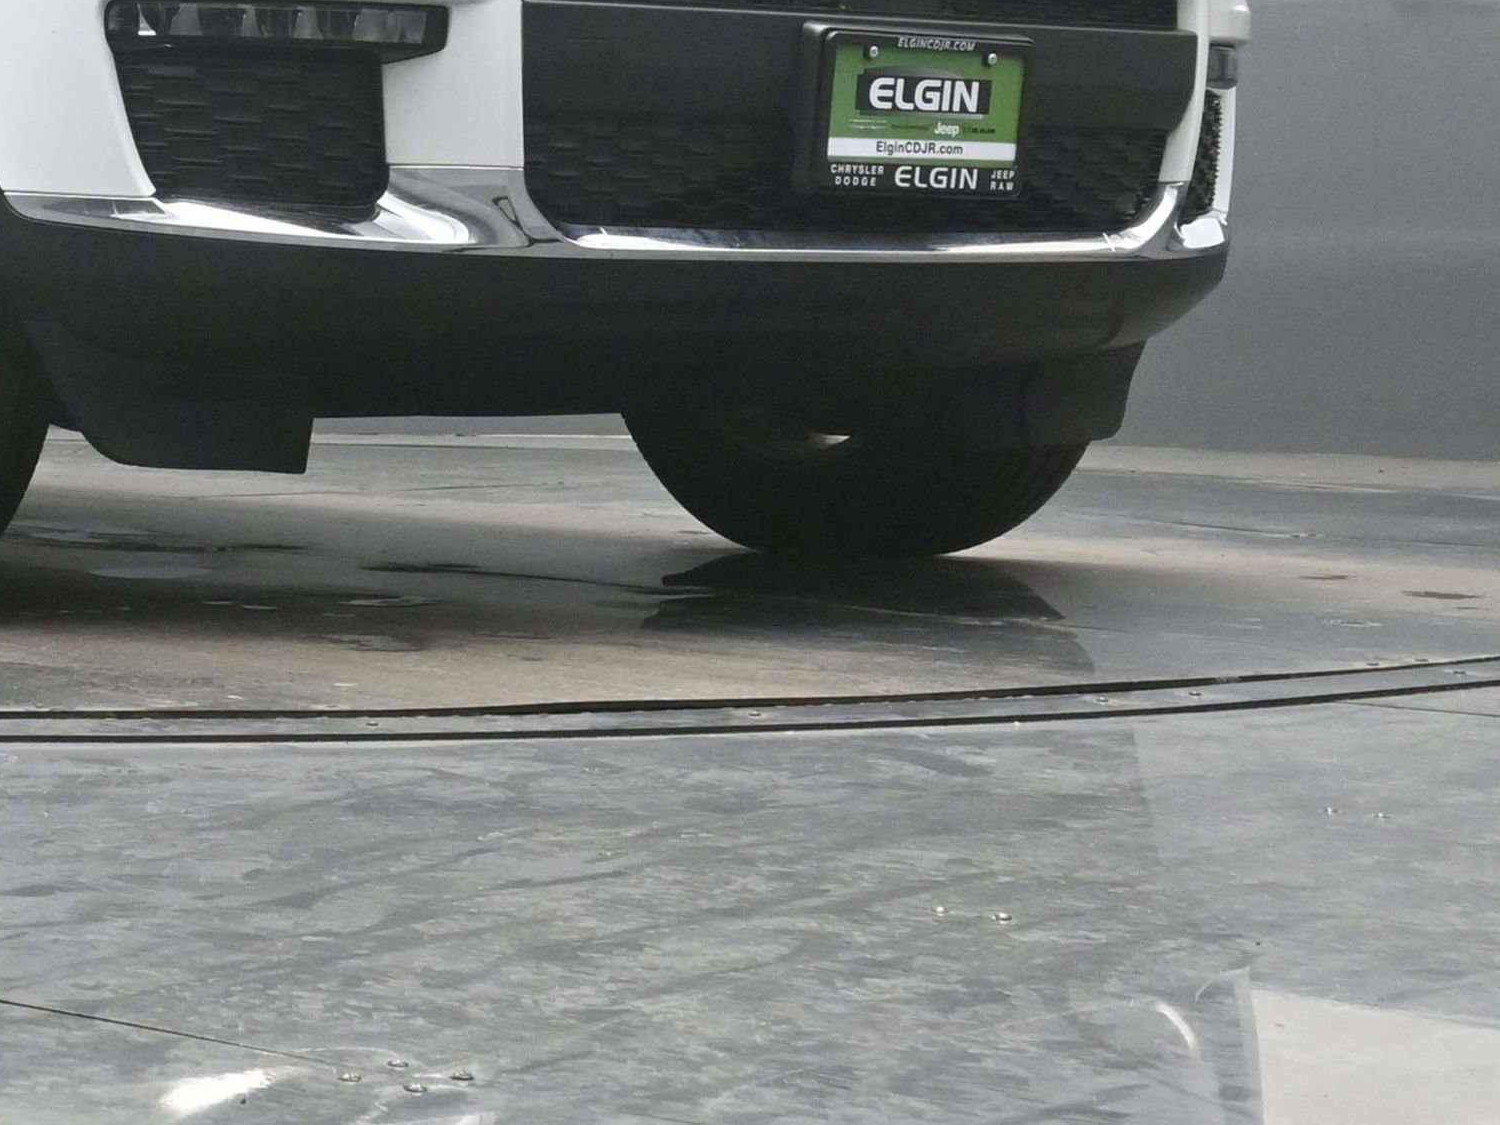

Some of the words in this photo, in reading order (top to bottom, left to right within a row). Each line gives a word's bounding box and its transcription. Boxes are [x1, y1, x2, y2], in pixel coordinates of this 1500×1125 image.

[897, 36, 976, 52] ELGINCDJR.COM
[868, 77, 980, 113] ELGIN
[933, 121, 960, 137] Jeep
[875, 141, 964, 156] ElginCDJR.com
[830, 163, 885, 176] CHRYSLER
[990, 169, 1016, 180] JEEP
[834, 176, 877, 187] DODGE
[894, 165, 978, 191] ELGIN
[990, 180, 1015, 192] RAM
